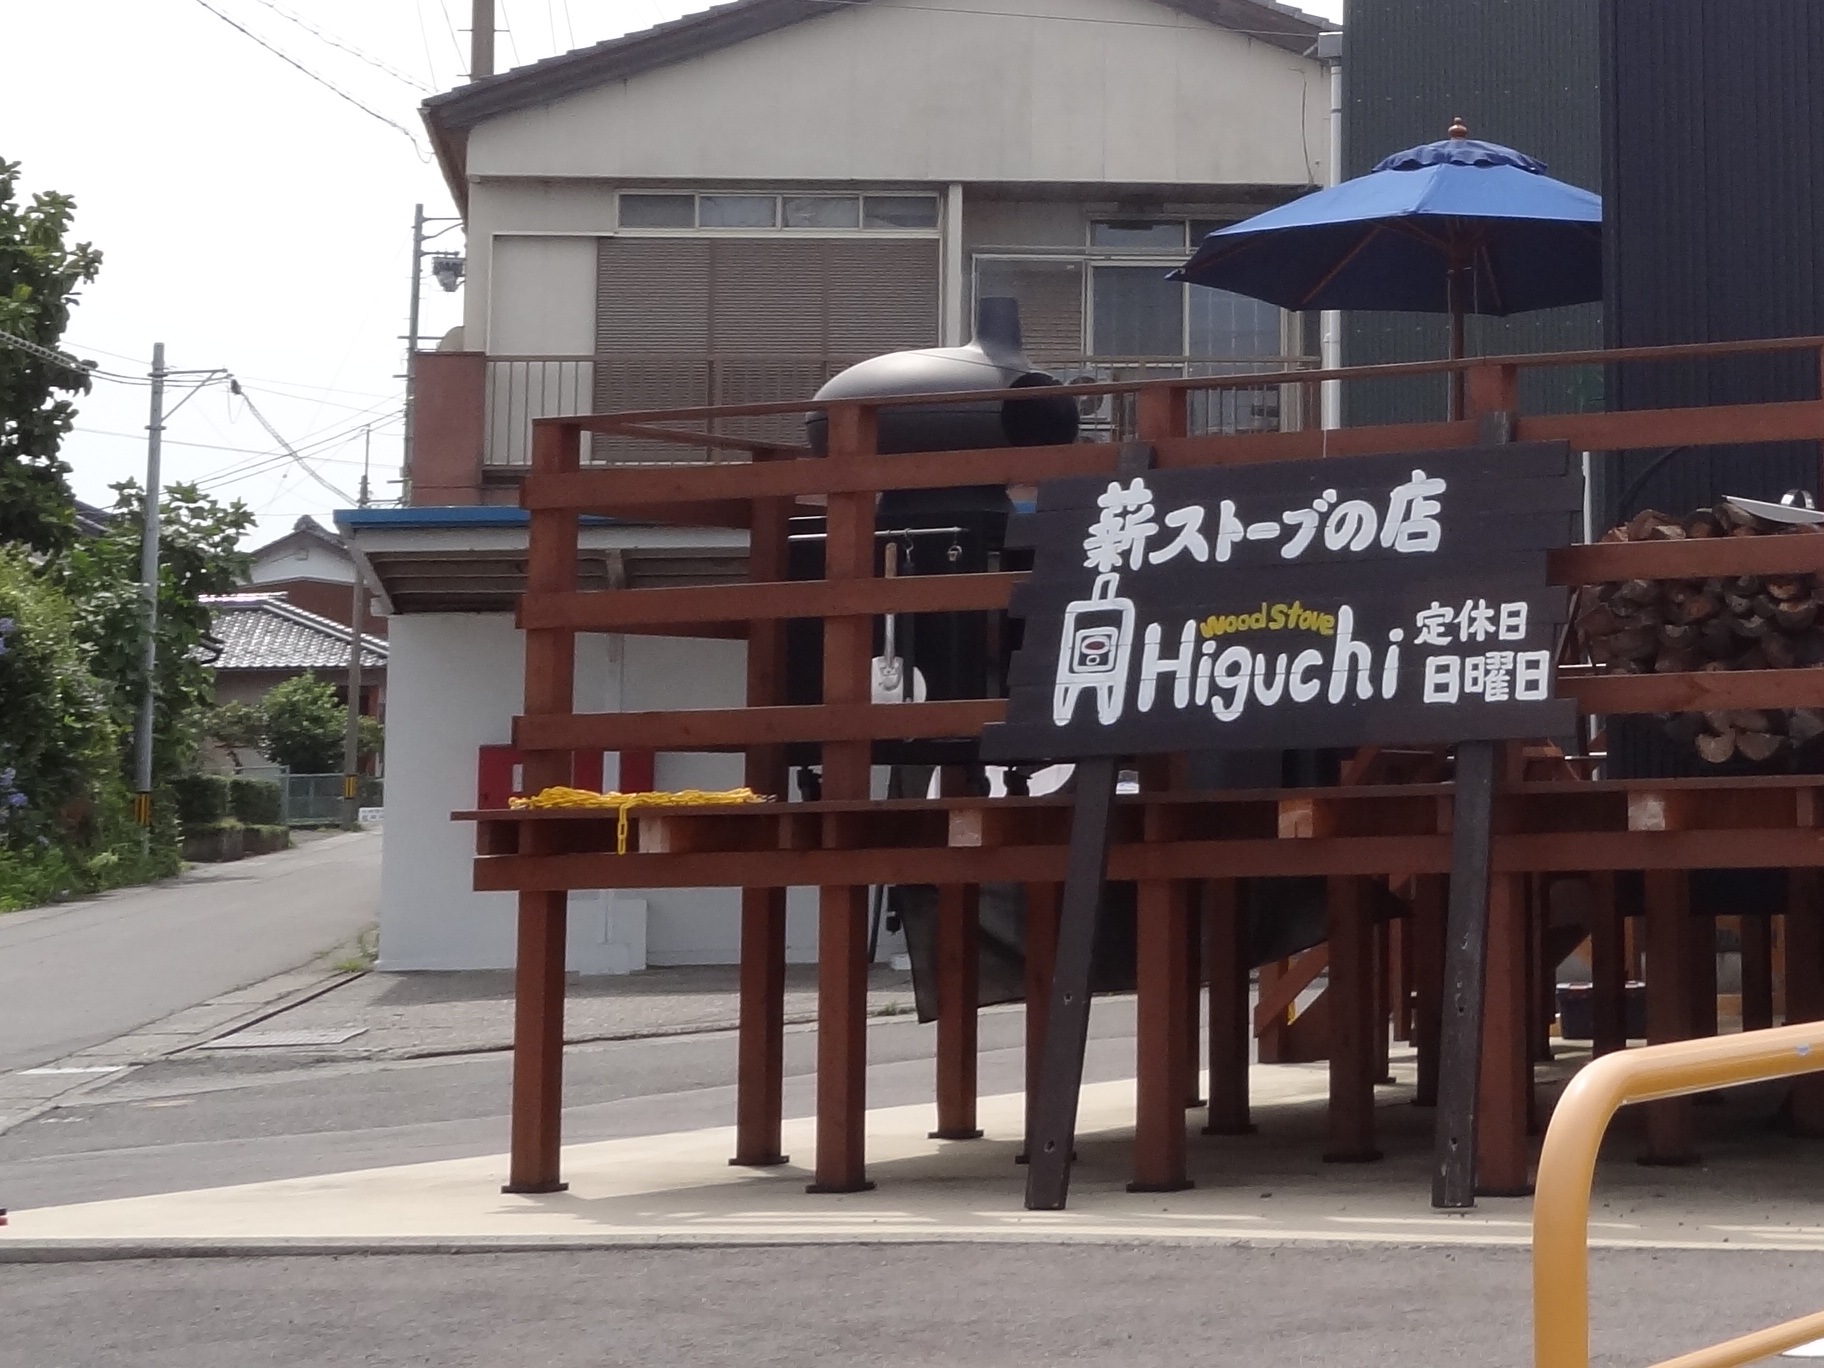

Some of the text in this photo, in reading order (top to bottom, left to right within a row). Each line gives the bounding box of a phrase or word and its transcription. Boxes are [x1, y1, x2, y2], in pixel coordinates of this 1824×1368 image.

[1084, 469, 1447, 572] 薪ストーブの店
[1414, 598, 1528, 647] 定休日
[1138, 604, 1403, 722] Higuchi
[1423, 650, 1550, 705] 日曜日
